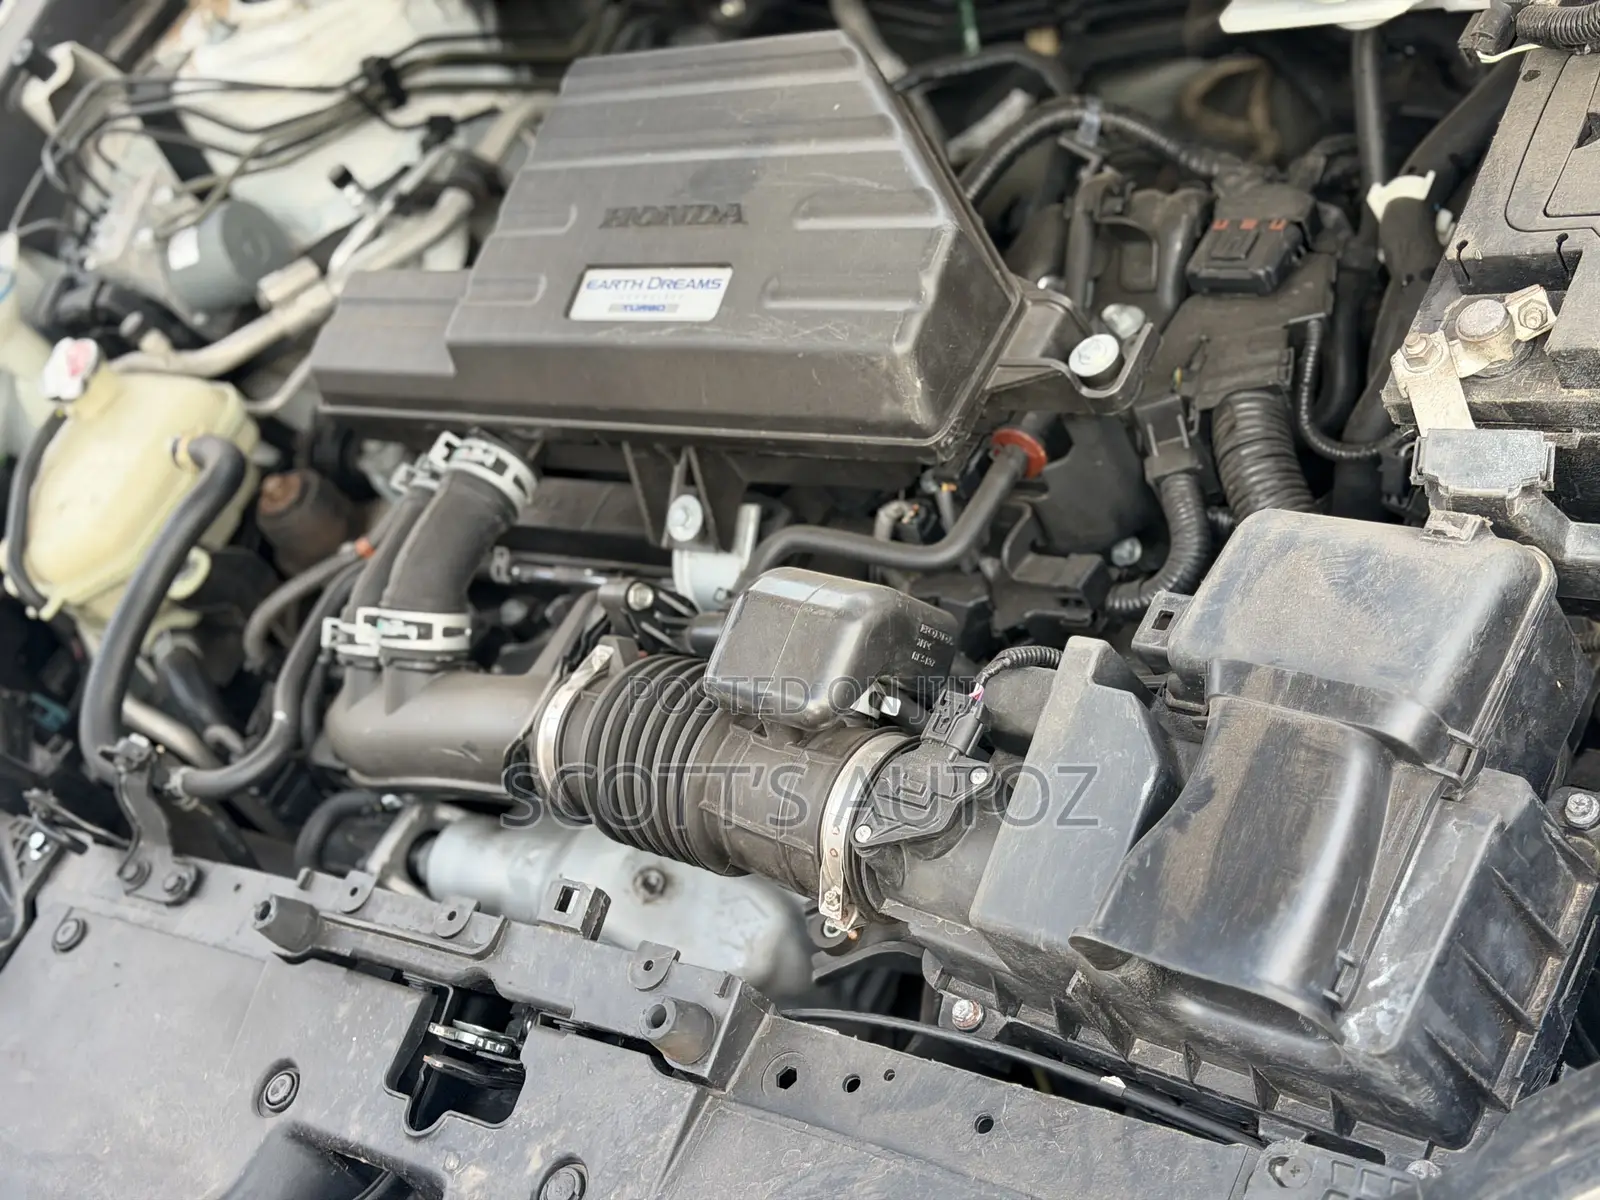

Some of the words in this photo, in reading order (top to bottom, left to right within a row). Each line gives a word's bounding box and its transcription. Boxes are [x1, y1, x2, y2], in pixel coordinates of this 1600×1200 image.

[599, 203, 748, 228] HONDA
[587, 279, 642, 290] EARTH
[647, 276, 722, 290] DREAMS
